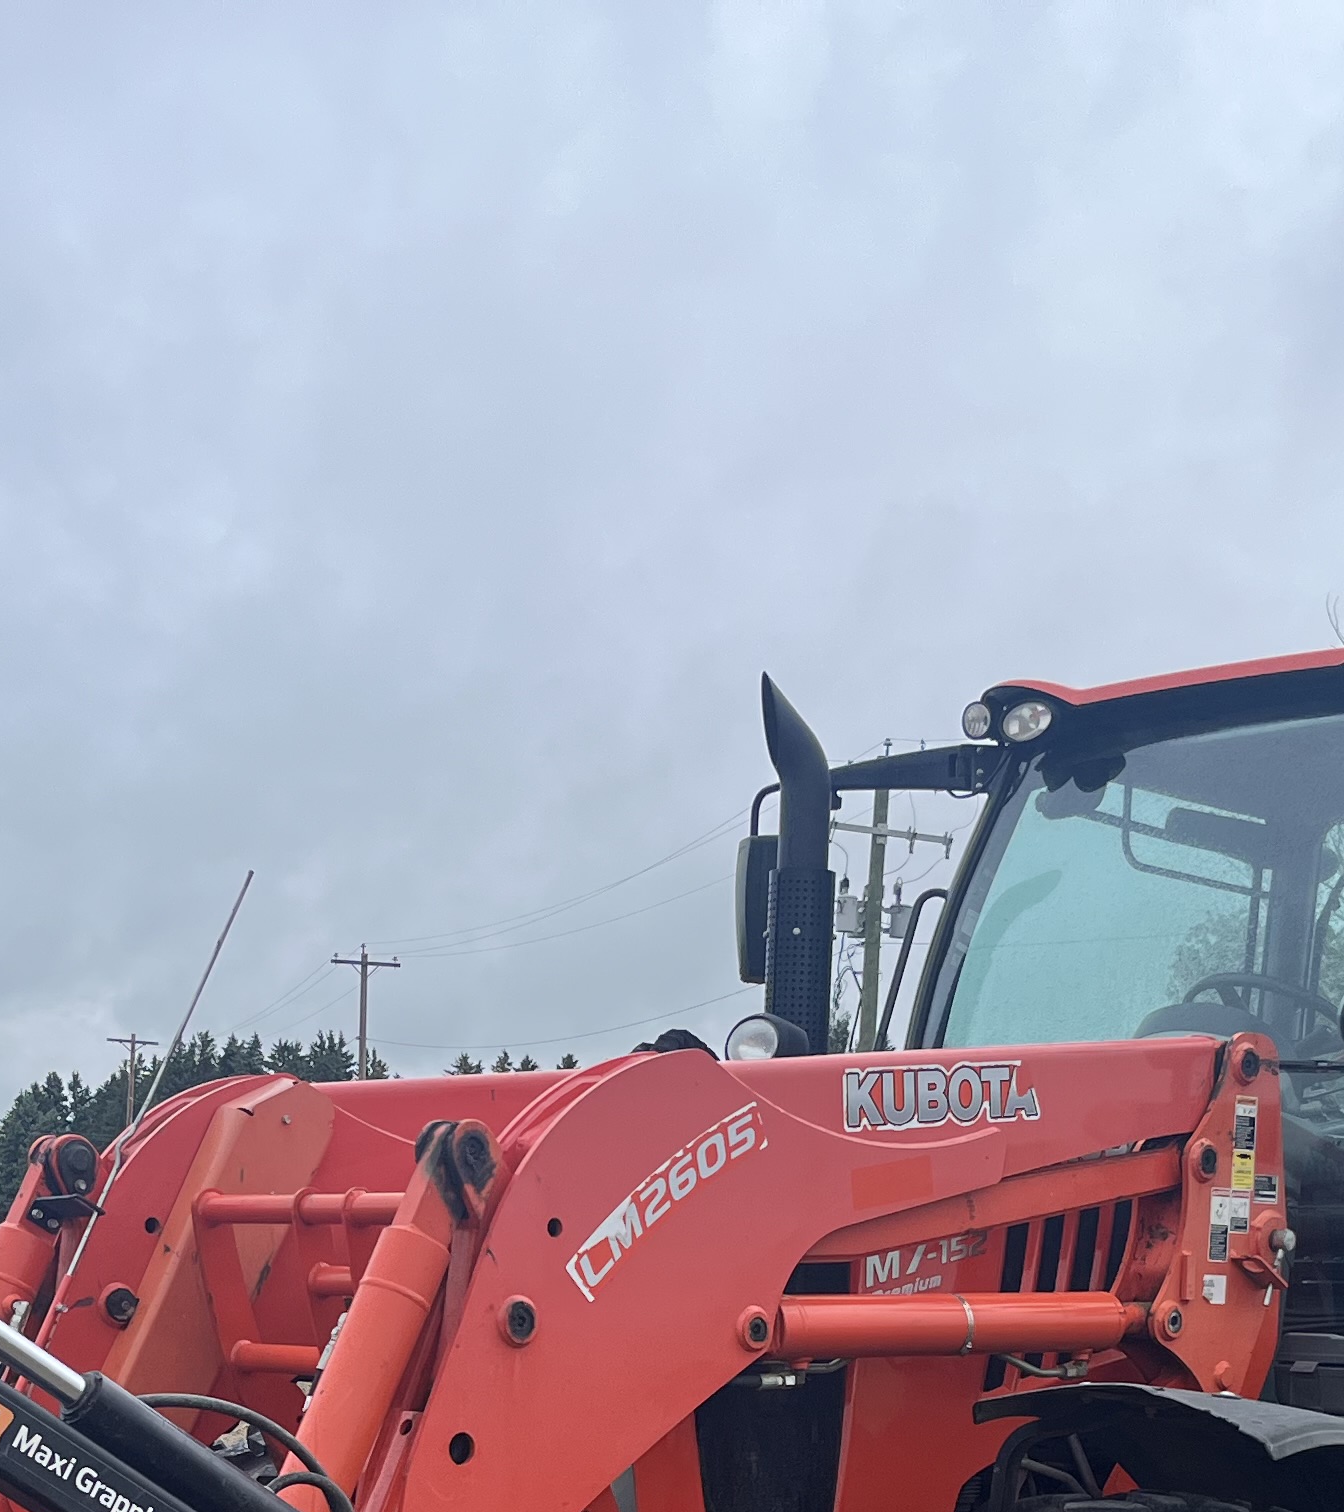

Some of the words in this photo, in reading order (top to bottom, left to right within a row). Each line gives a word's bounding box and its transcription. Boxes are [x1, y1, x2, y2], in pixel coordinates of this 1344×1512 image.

[845, 1064, 1039, 1128] KUBOTA
[579, 1113, 756, 1287] LM2605
[11, 1424, 77, 1481] Maxi
